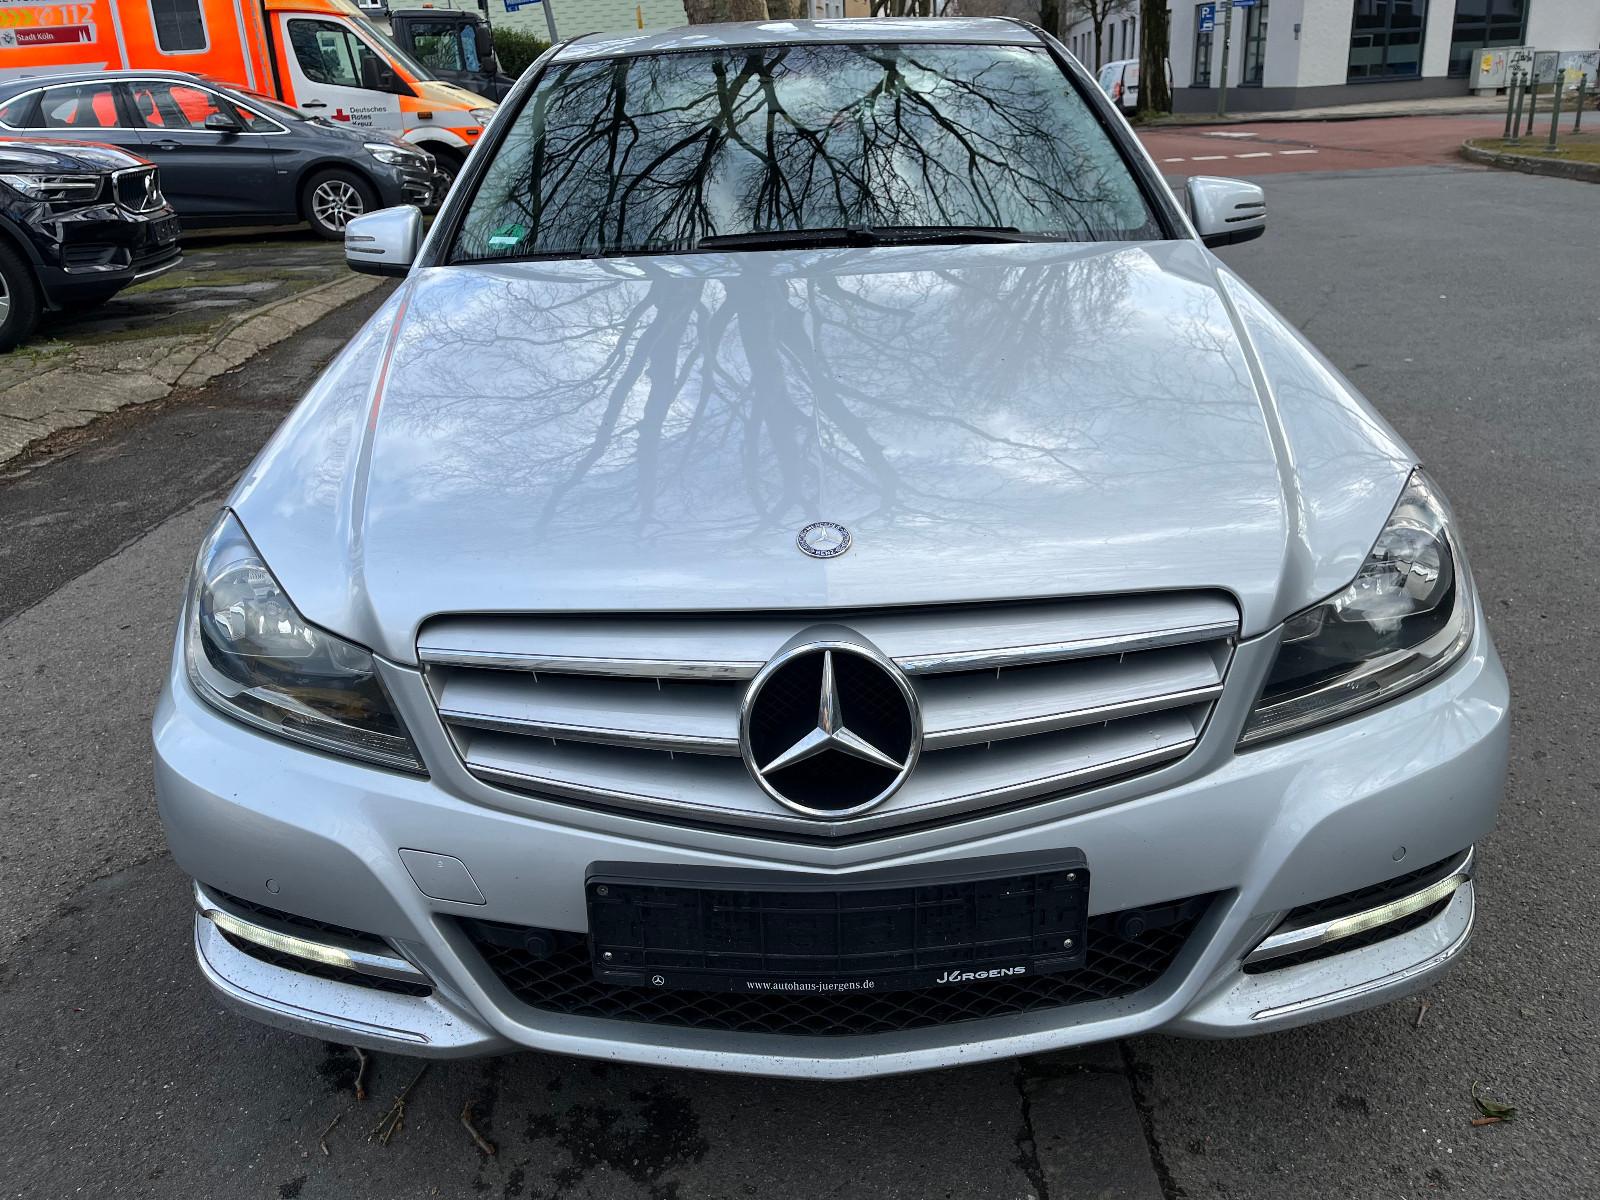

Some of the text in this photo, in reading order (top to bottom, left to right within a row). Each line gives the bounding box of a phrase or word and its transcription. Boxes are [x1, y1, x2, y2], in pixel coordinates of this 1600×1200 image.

[60, 4, 94, 25] 112
[1202, 7, 1210, 18] P
[16, 32, 54, 41] Stadt Köln
[936, 966, 1026, 984] JÜRGENS
[746, 979, 875, 992] www.autohaus-juergens.de
